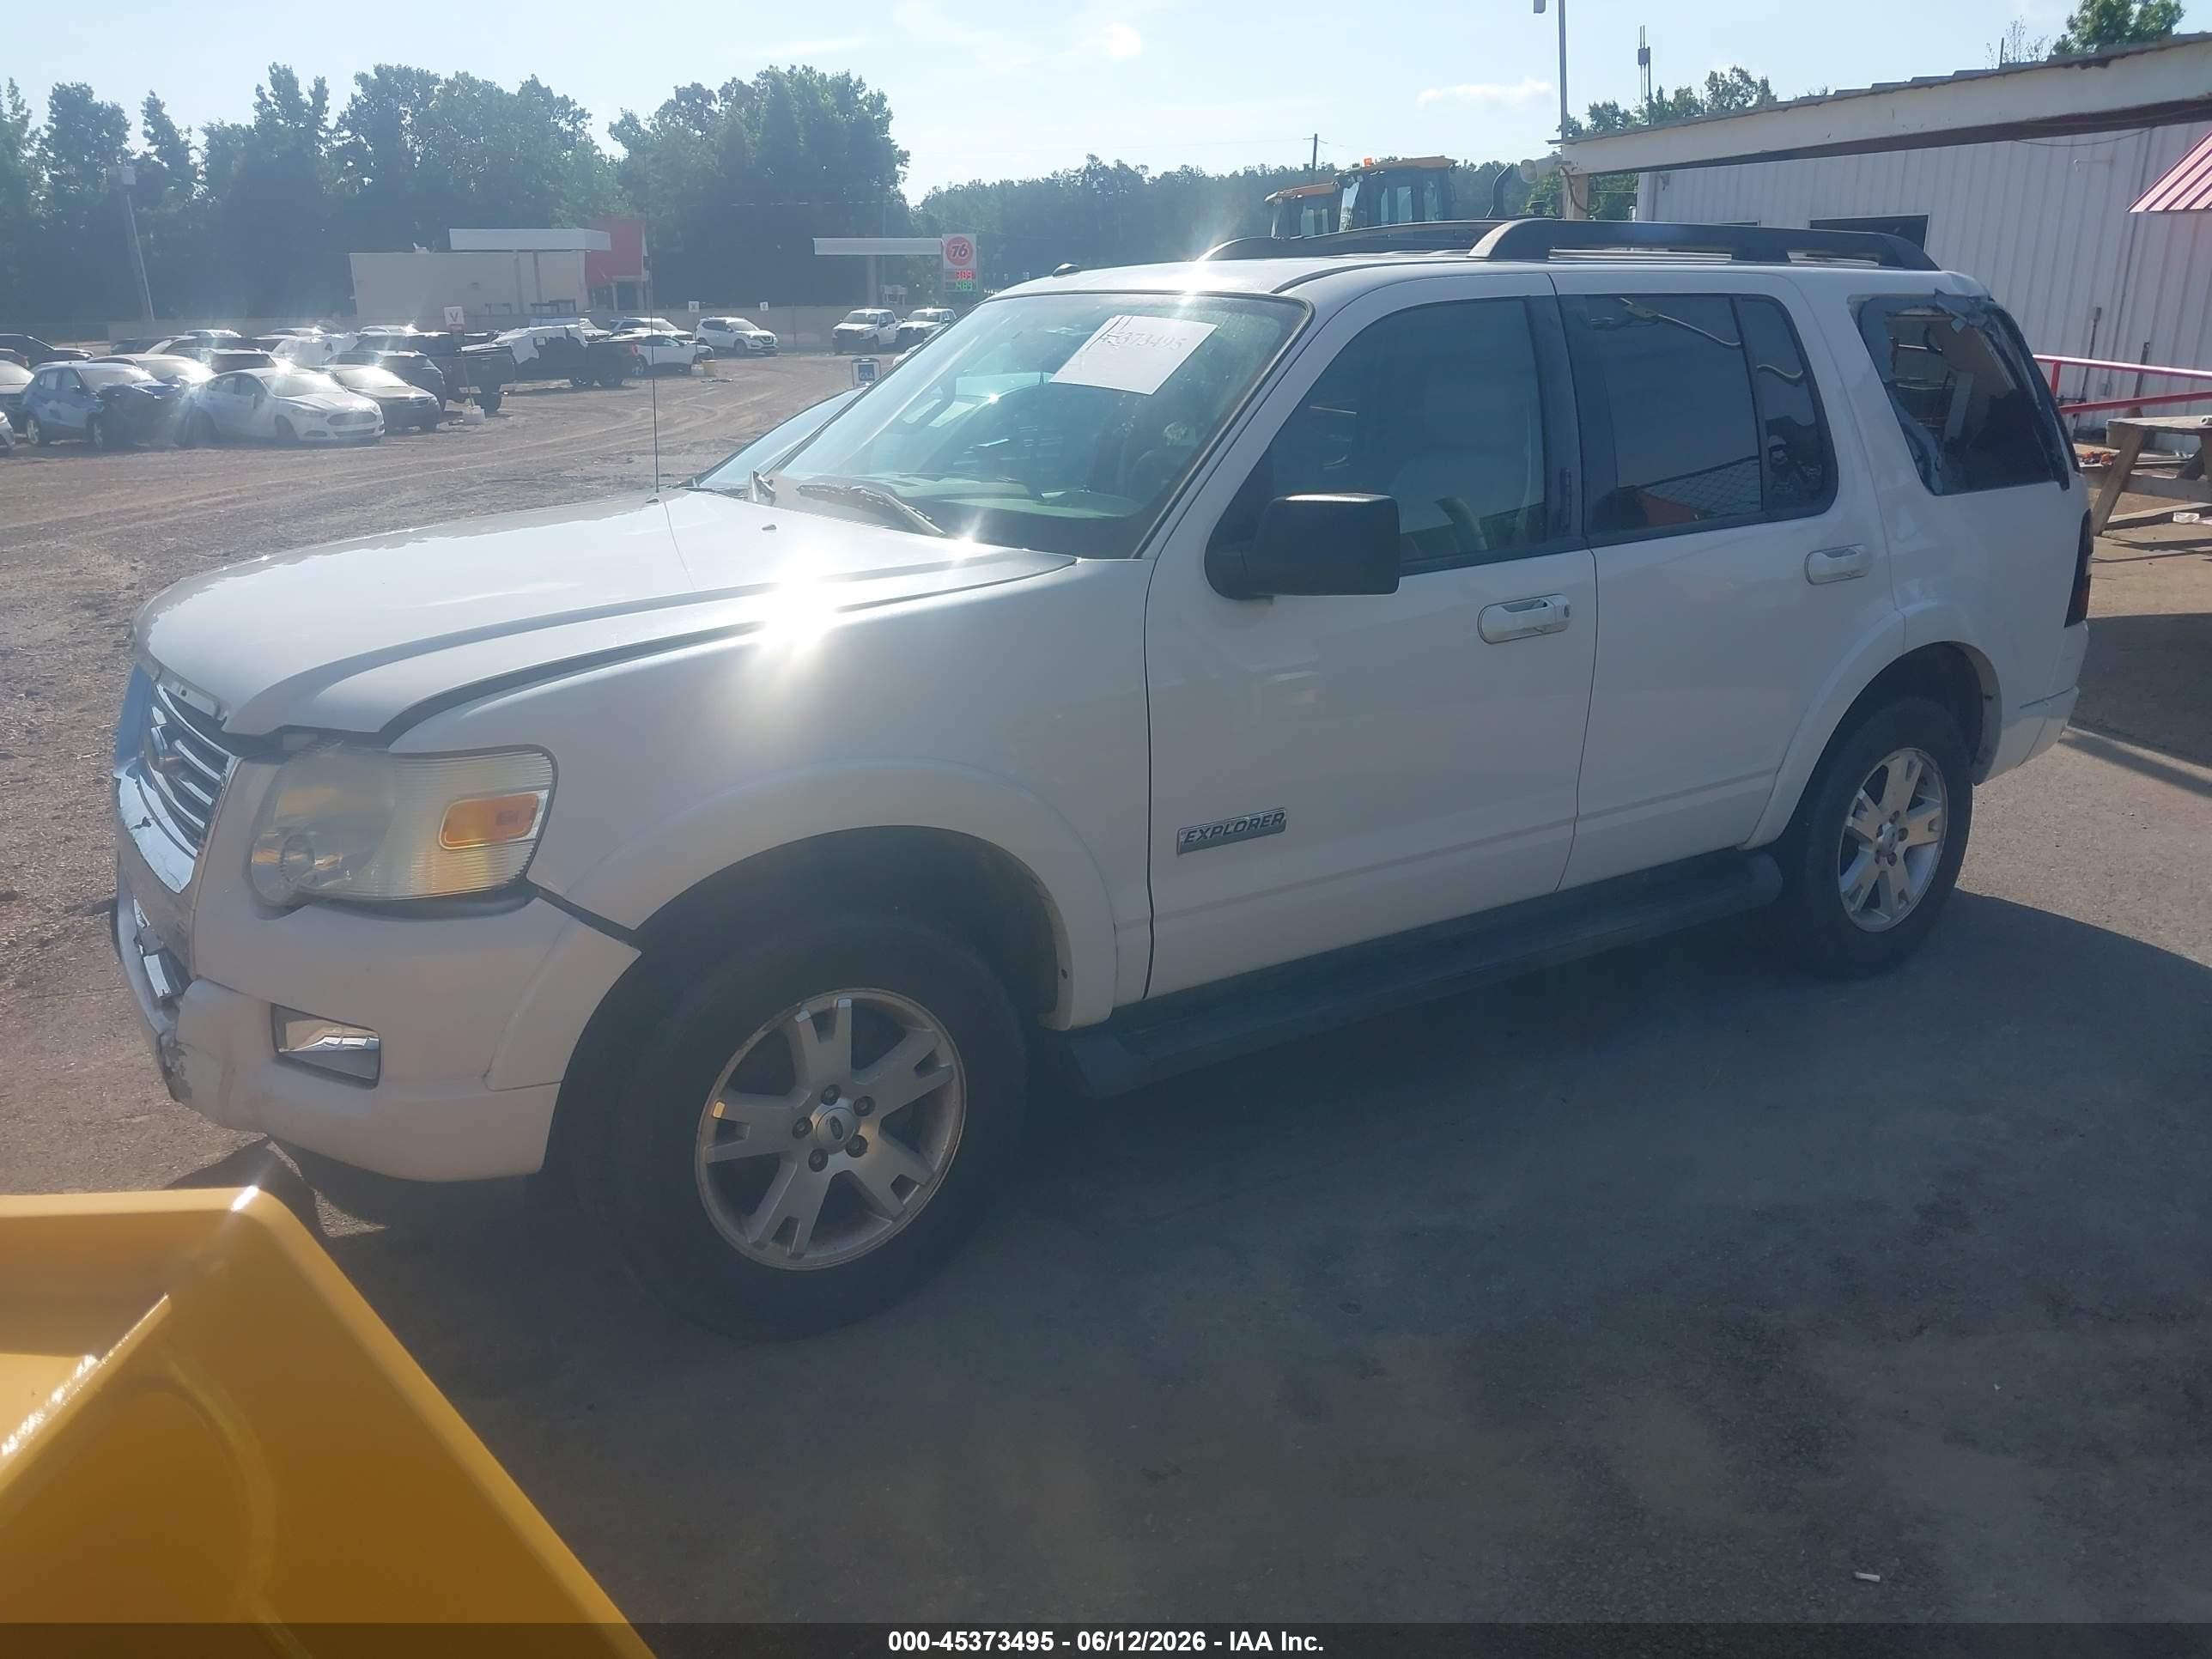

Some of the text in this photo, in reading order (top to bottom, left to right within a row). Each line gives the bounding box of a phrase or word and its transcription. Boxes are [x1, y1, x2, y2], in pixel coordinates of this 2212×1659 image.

[951, 242, 969, 258] 76
[449, 312, 459, 323] V
[1183, 811, 1285, 843] EXPLORER
